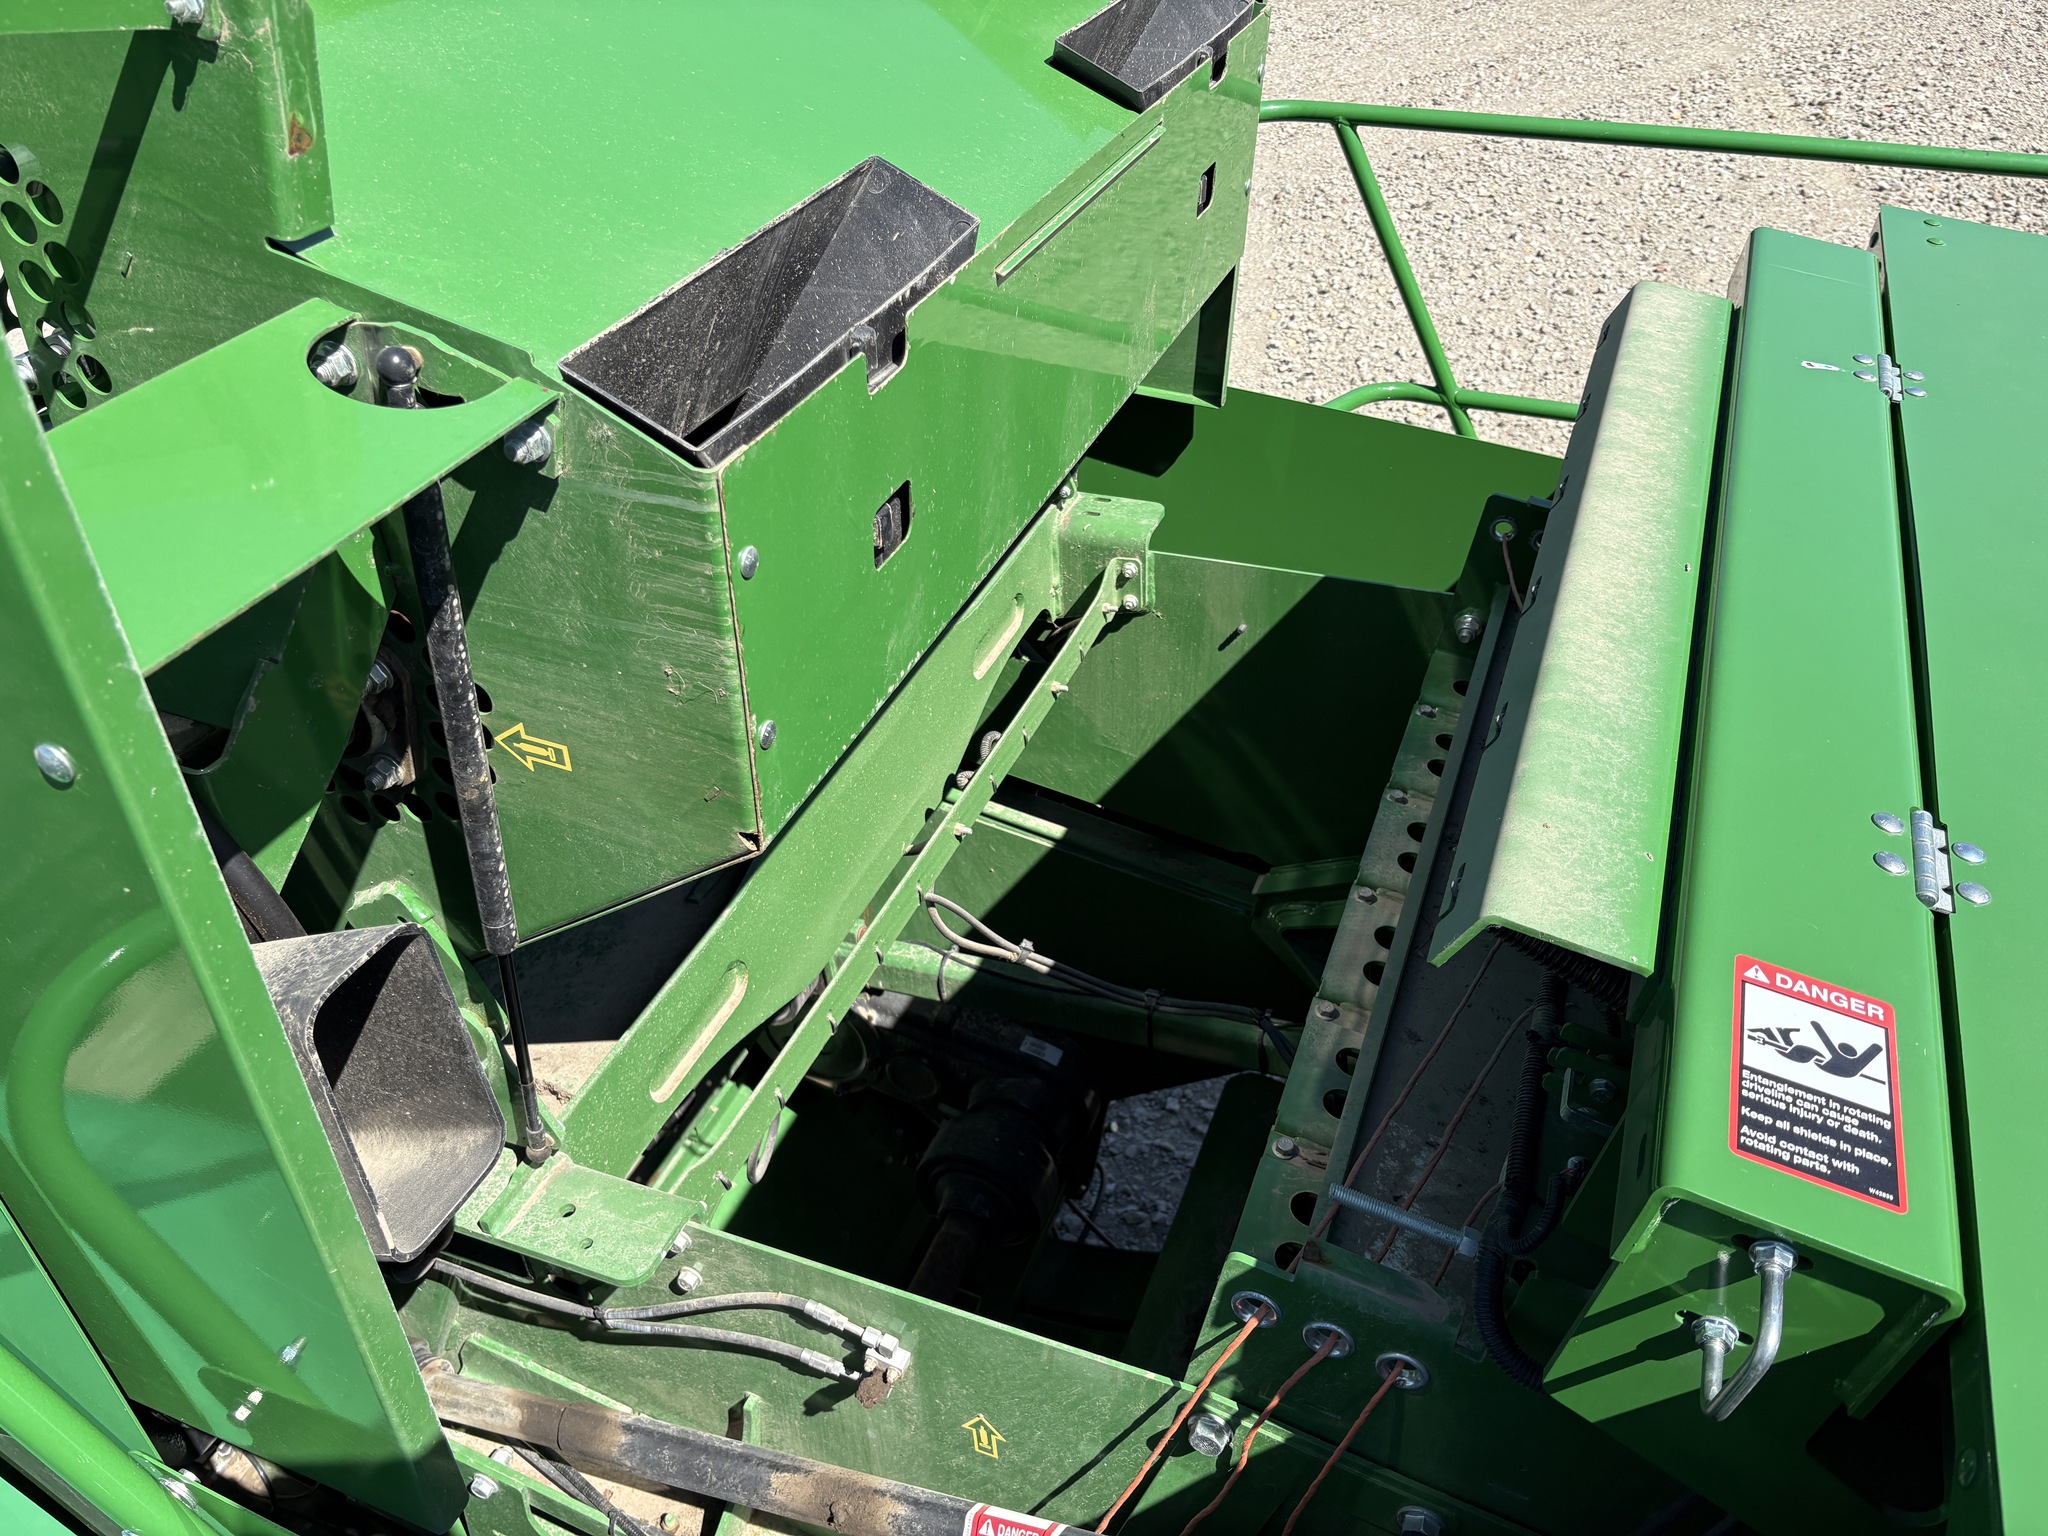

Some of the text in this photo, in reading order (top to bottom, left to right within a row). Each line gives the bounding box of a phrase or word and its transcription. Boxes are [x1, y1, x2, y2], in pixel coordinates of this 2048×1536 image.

[1775, 972, 1885, 1021] DANGER
[1741, 1079, 1859, 1126] driveline can cause
[1741, 1089, 1786, 1110] serious
[1789, 1103, 1824, 1124] injury
[1826, 1117, 1841, 1129] or
[1742, 1068, 1892, 1130] Entanglement in rotating
[1740, 1135, 1790, 1161] rotating
[1740, 1124, 1860, 1175] Avoid contact with
[1741, 1105, 1773, 1125] Keep
[1775, 1119, 1790, 1131] all
[1793, 1125, 1837, 1147] shields
[1840, 1140, 1851, 1153] in
[998, 1524, 1039, 1536] DANG
